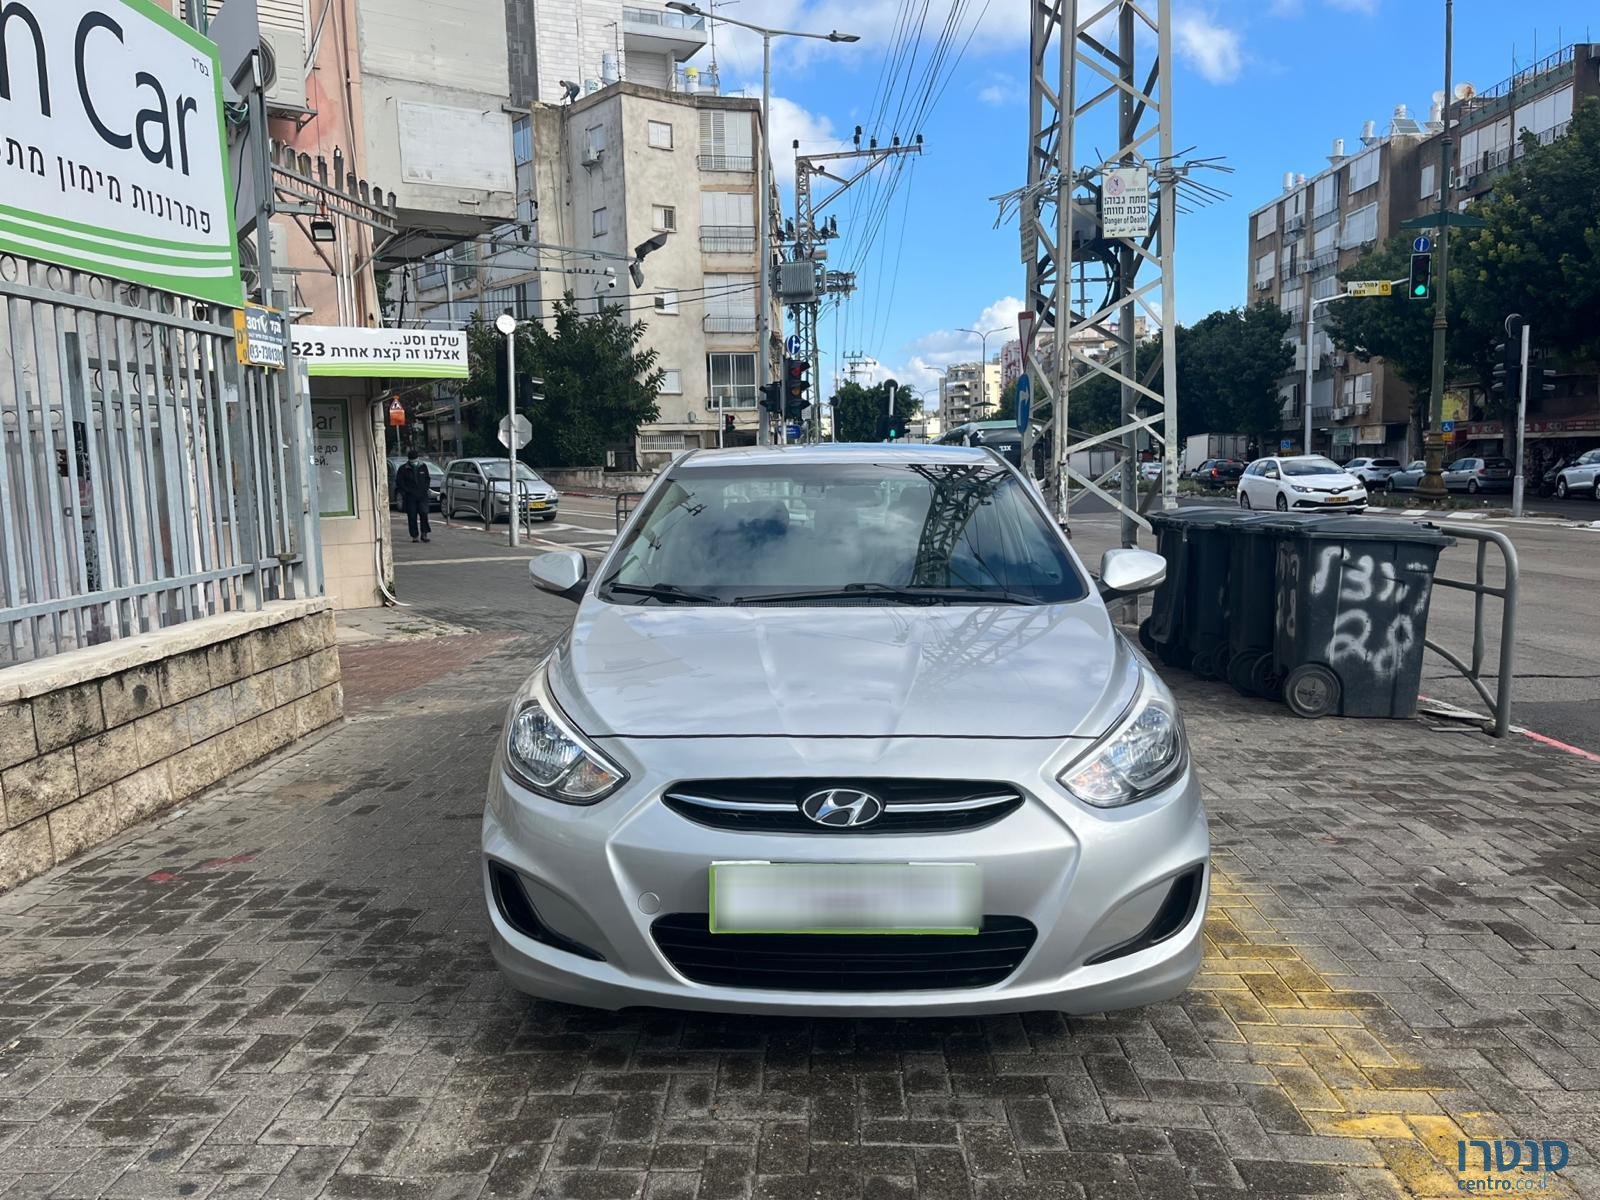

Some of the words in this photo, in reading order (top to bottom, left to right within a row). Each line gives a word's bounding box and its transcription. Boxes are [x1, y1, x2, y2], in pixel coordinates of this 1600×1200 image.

[74, 11, 198, 176] Car
[0, 136, 46, 177] מת
[57, 155, 123, 203] מימון
[131, 183, 211, 235] פתרונות
[1104, 216, 1123, 225] Danger
[1123, 216, 1130, 224] of
[430, 334, 459, 347] שלם
[331, 346, 368, 358] אחרת
[373, 347, 400, 361] קצת
[405, 349, 419, 359] זה
[424, 348, 460, 361] אצלנו
[325, 445, 338, 455] до
